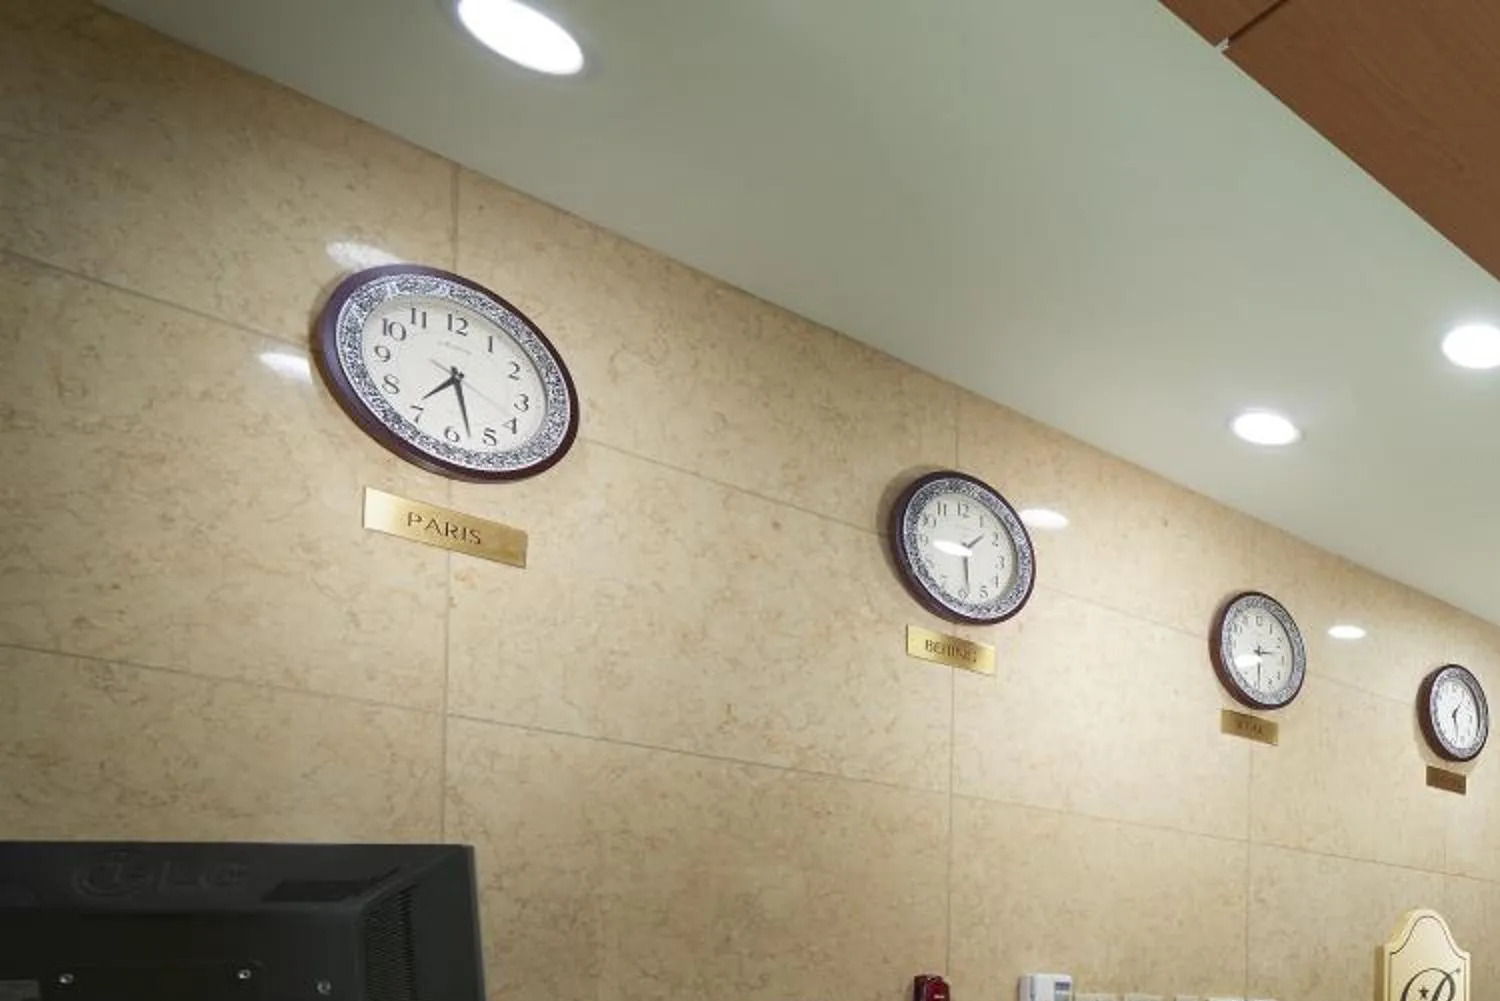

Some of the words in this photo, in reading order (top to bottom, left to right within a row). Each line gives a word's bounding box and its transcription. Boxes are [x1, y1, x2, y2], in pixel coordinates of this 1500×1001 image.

[411, 307, 427, 329] 11
[447, 313, 469, 337] 12
[382, 318, 407, 341] 10
[374, 345, 391, 362] 9
[487, 336, 493, 352] 1
[508, 361, 520, 381] 2
[382, 374, 400, 395] 8
[514, 394, 529, 412] 3
[410, 404, 424, 424] 7
[444, 426, 461, 443] 6
[502, 416, 517, 434] 4
[483, 427, 497, 446] 5
[407, 511, 482, 545] PARIS
